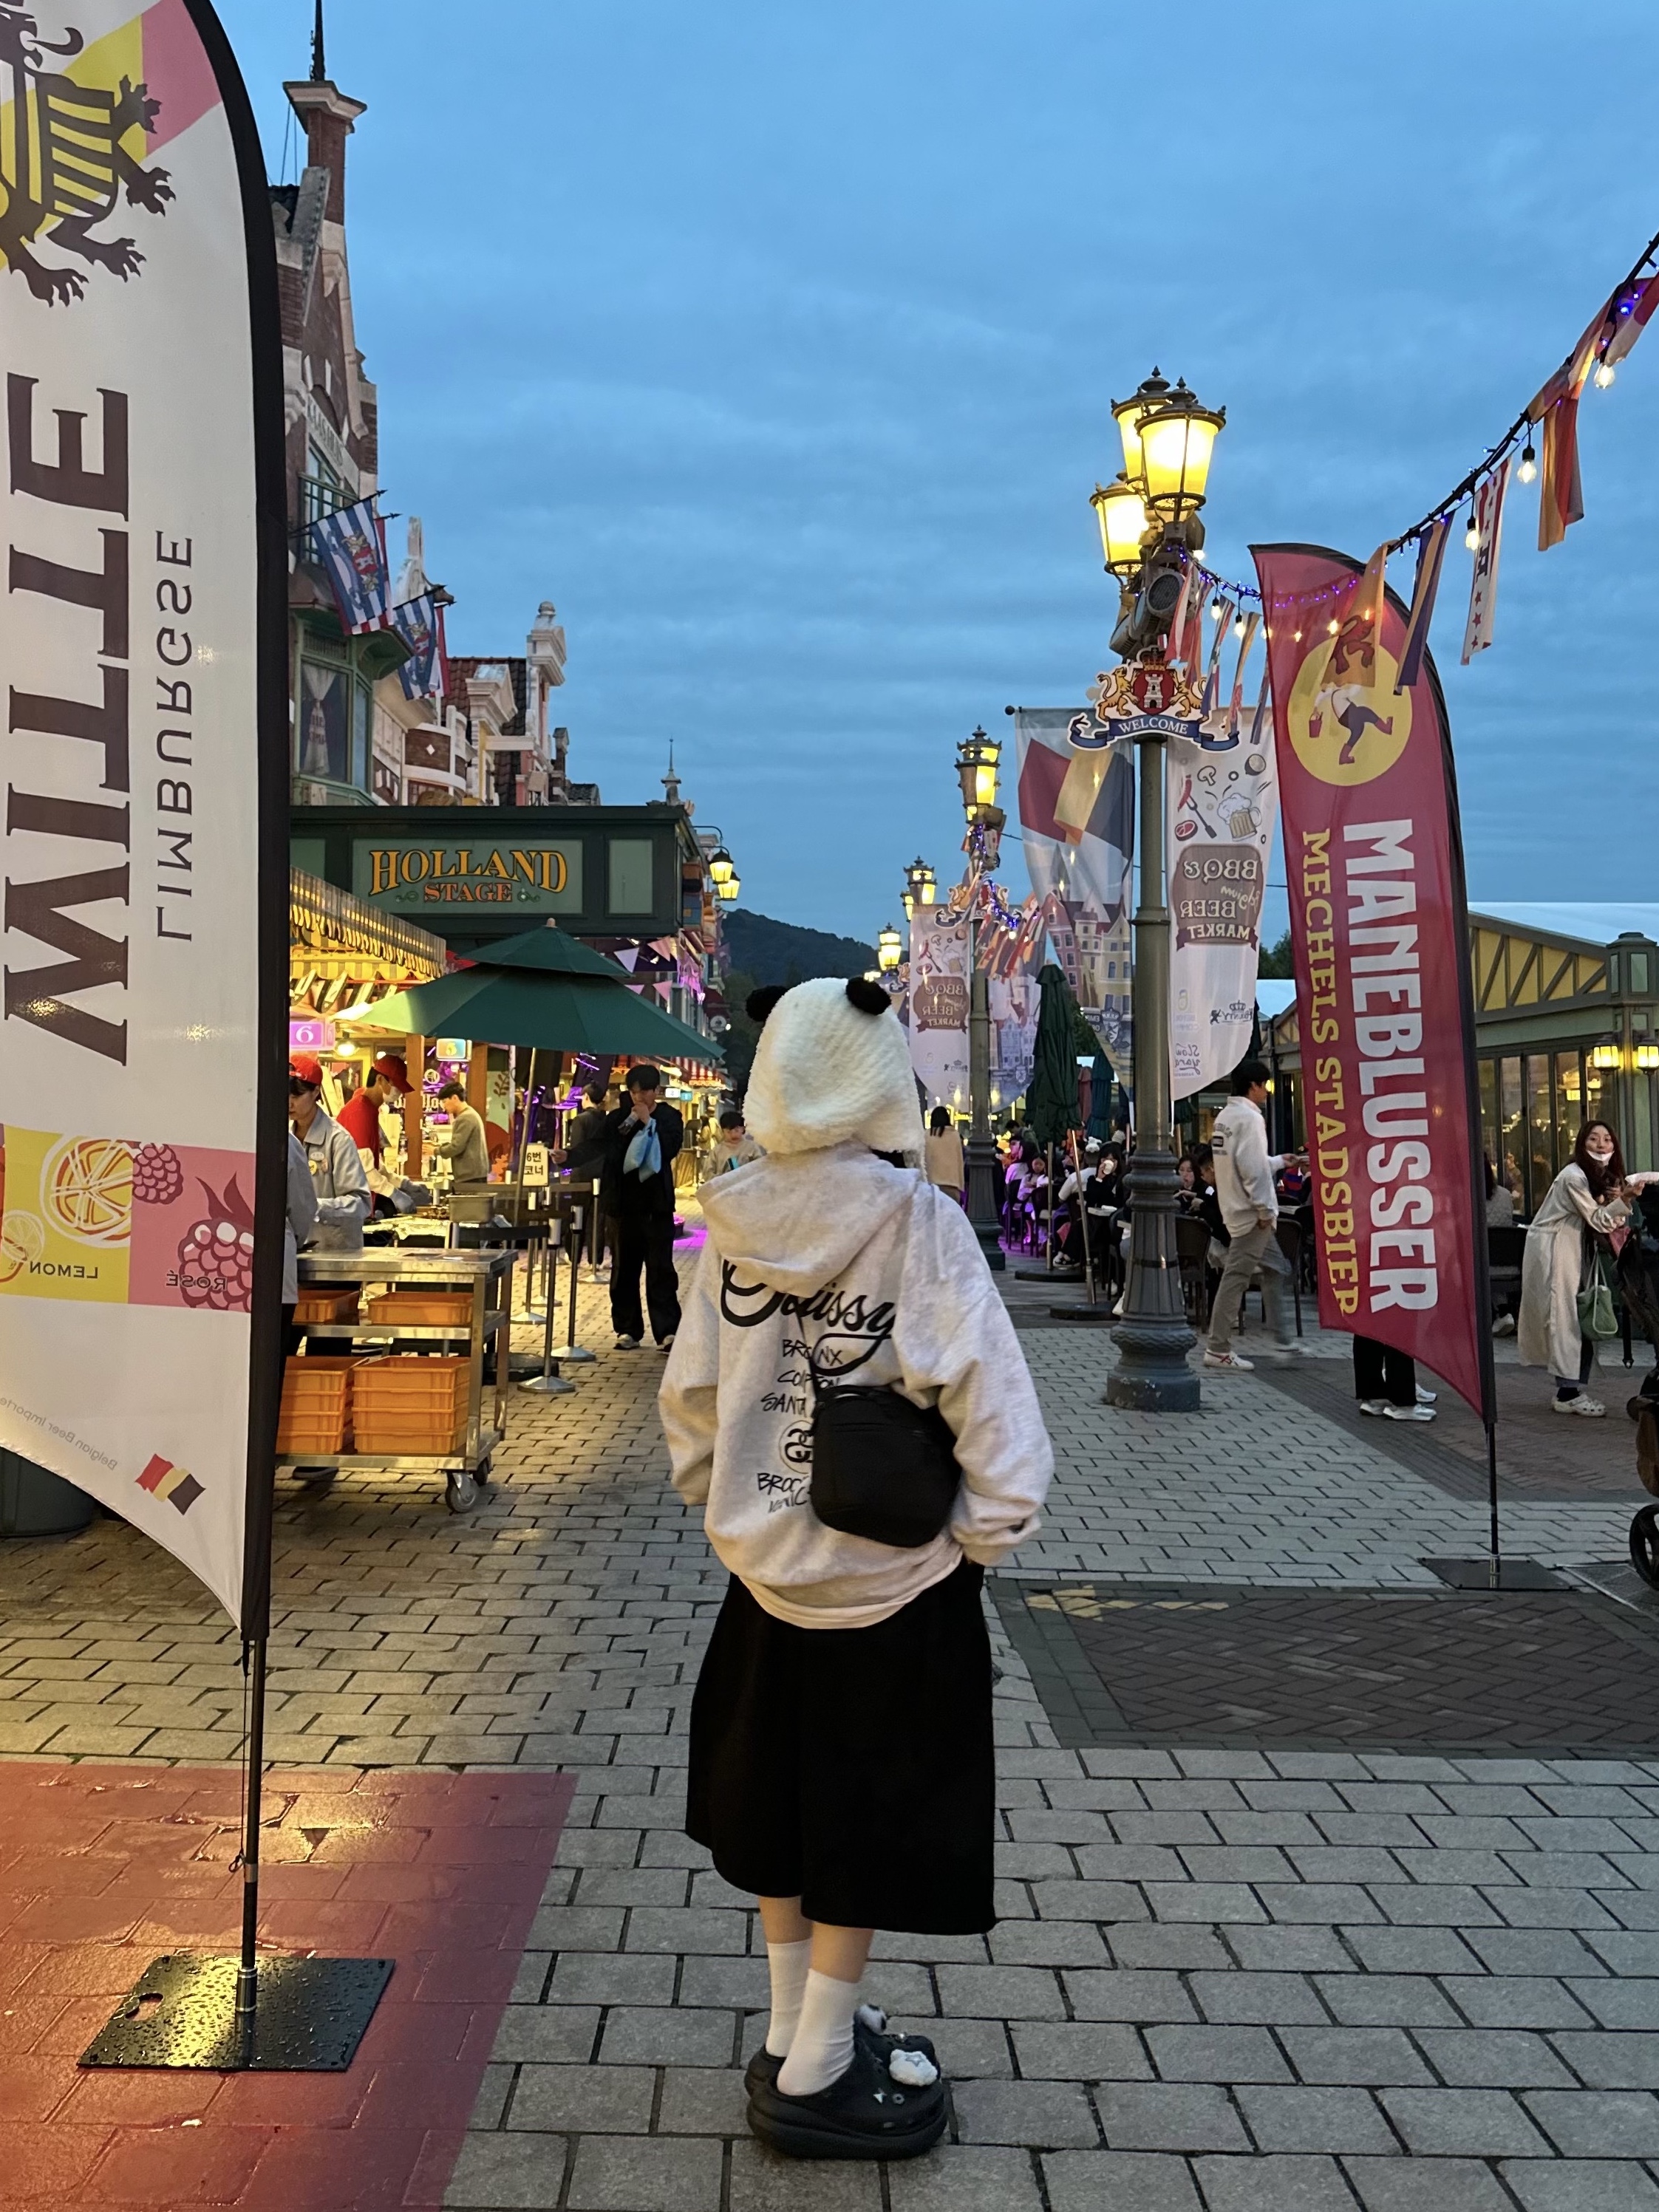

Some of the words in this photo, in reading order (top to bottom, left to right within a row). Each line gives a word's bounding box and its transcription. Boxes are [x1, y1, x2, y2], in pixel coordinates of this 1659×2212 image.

[1118, 717, 1189, 734] WELCOME
[369, 849, 568, 896] HOLLAND
[423, 882, 512, 902] STAGE
[1301, 827, 1340, 1044] MECHELS
[296, 1025, 314, 1043] 6
[1342, 818, 1440, 1314] MANEBLUSSER
[526, 1152, 542, 1163] 6번
[524, 1164, 544, 1175] 코너
[1315, 1056, 1361, 1317] STADSBIER
